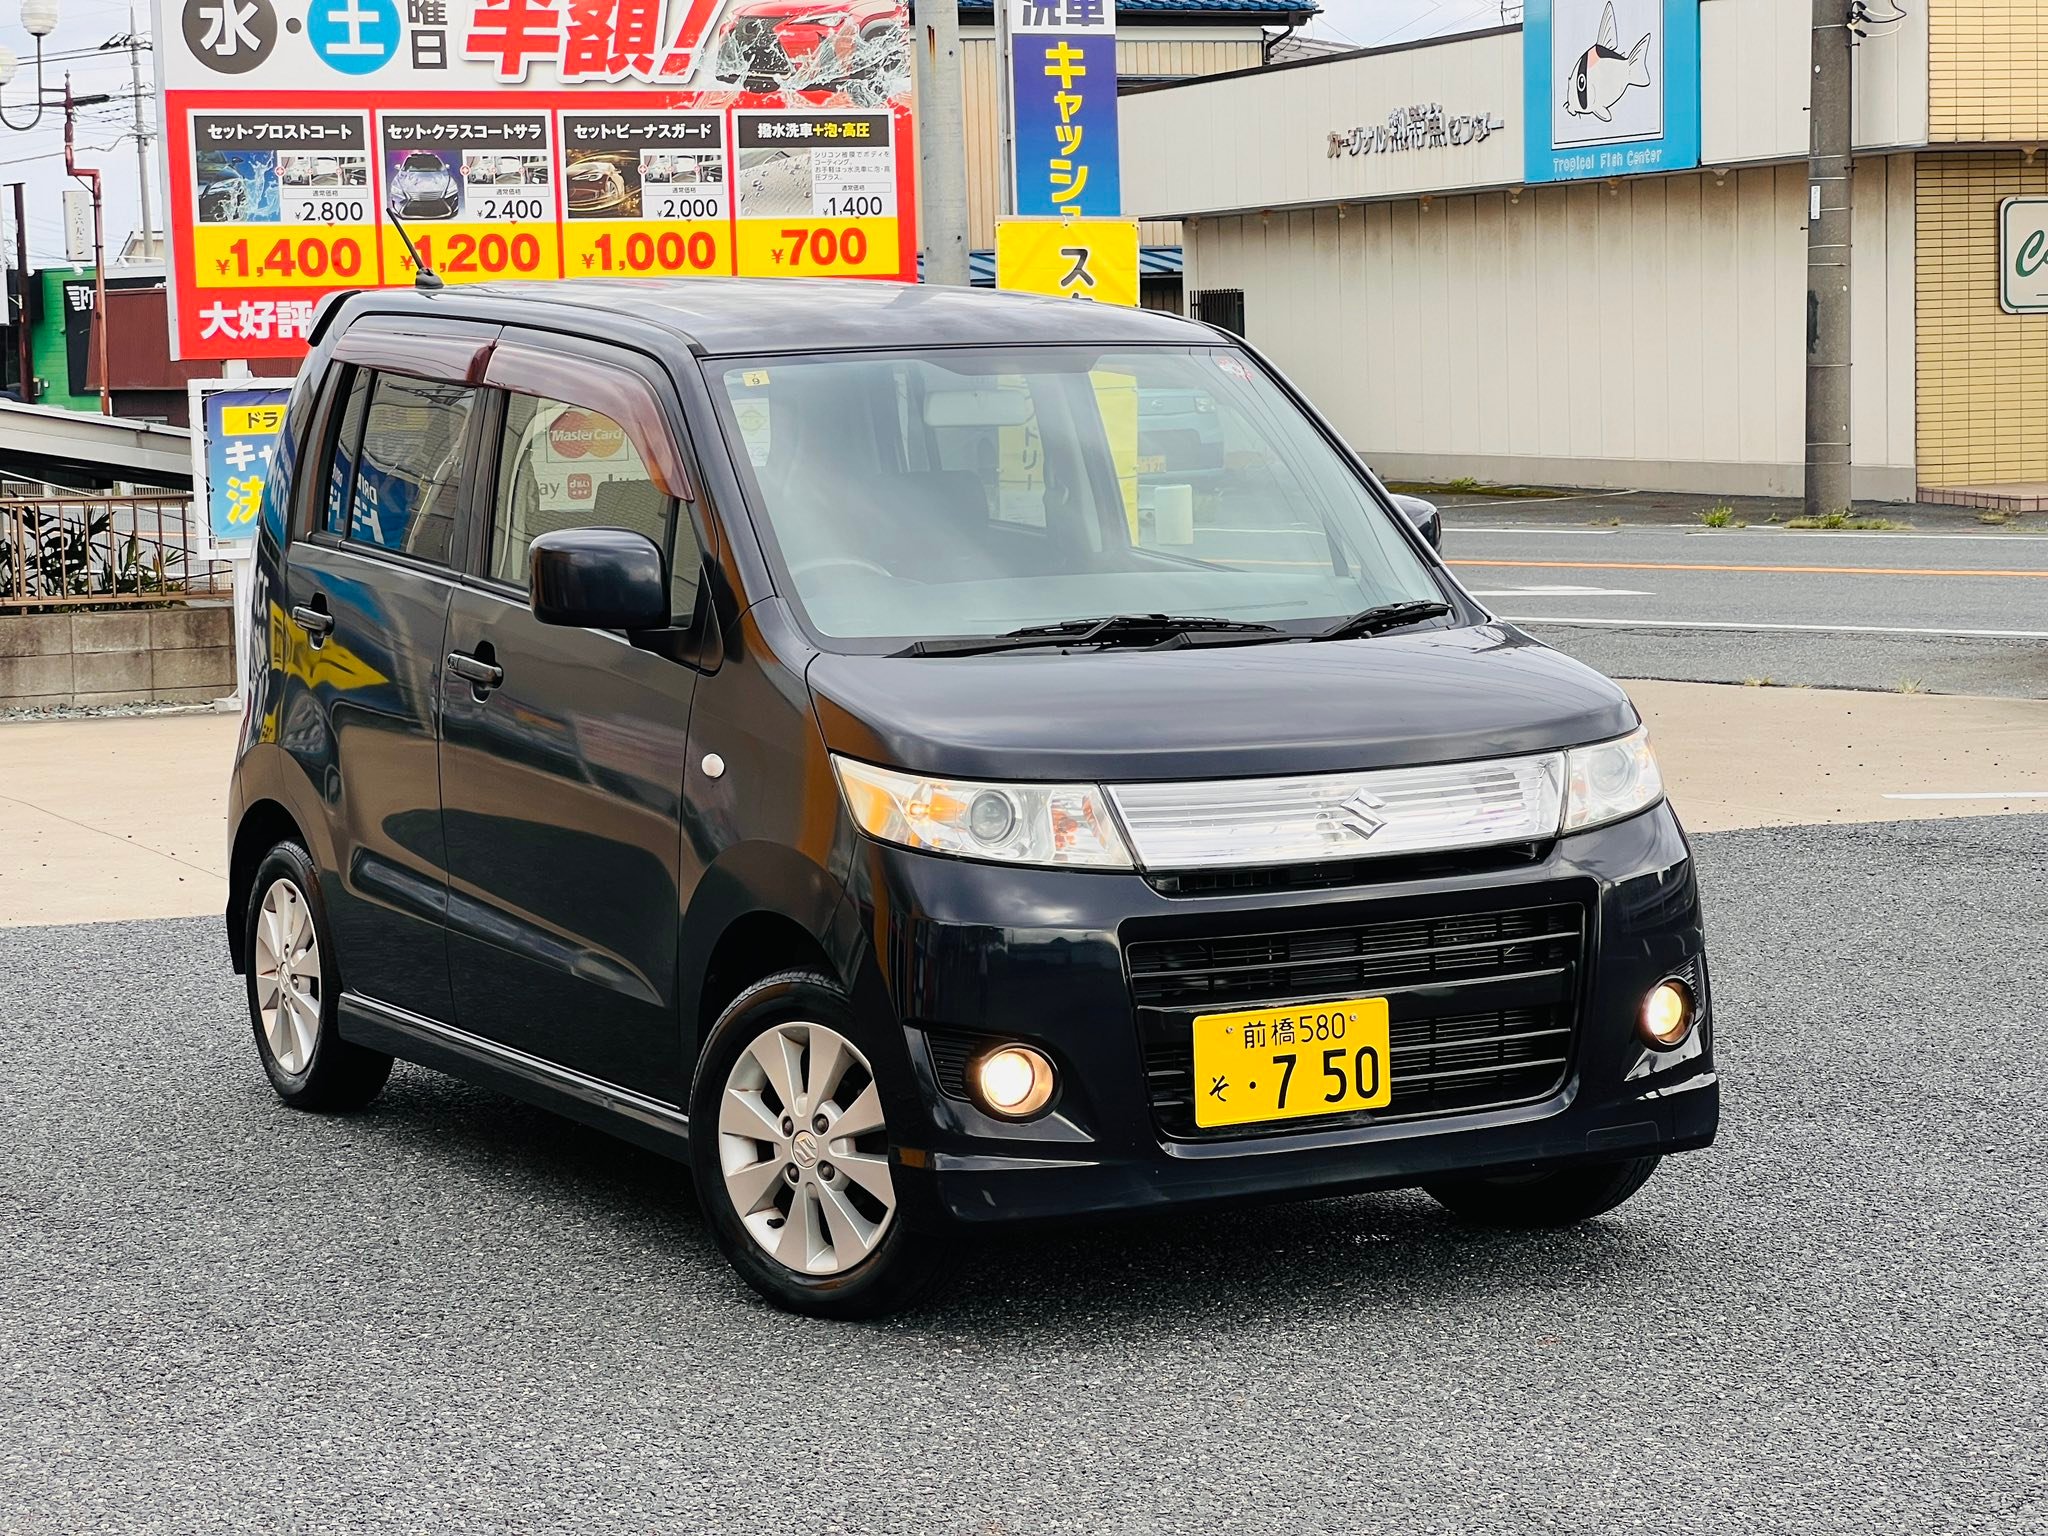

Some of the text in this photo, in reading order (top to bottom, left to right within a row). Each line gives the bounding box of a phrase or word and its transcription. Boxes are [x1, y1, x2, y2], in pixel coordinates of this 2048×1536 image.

[1553, 148, 1662, 173] Tropical Fish Center
[295, 201, 363, 222] ¥2,800
[478, 199, 543, 220] ¥2,400
[657, 199, 718, 219] ¥2,000
[823, 196, 882, 216] ¥1,400
[216, 238, 362, 278] ¥1,400
[582, 231, 716, 272] ¥1,000
[771, 227, 867, 267] ¥700
[1209, 1075, 1230, 1102] そ
